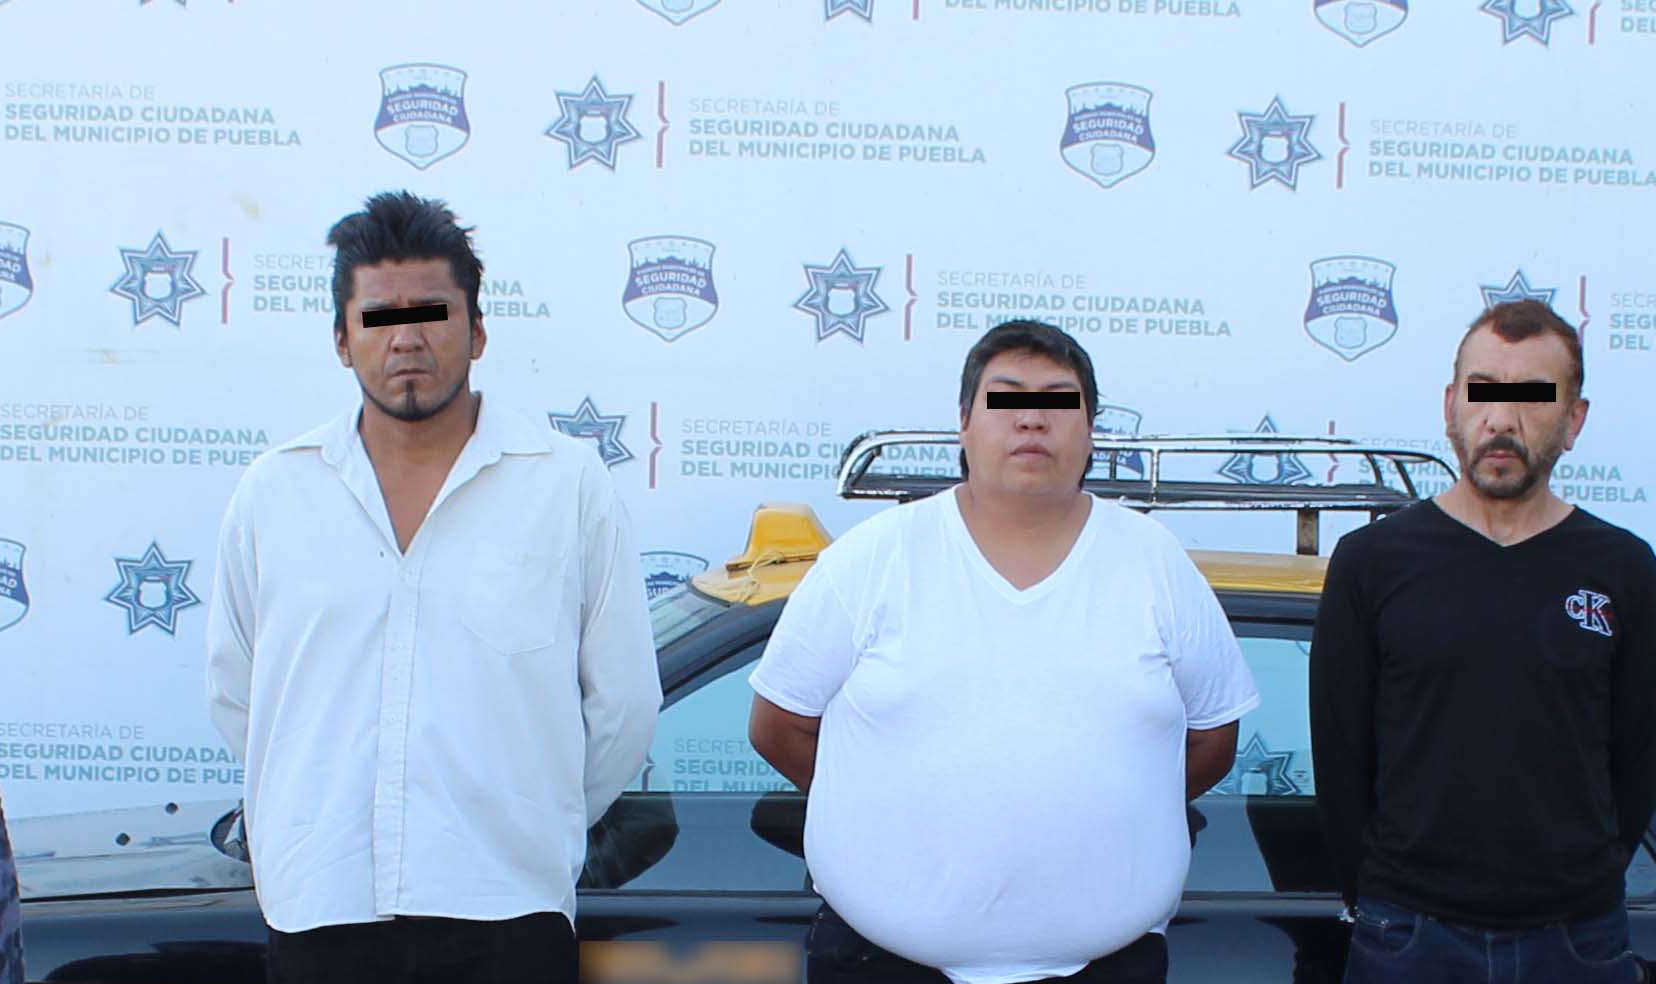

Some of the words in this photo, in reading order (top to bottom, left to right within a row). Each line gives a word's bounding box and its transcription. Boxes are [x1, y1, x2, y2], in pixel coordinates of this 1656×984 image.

[5, 103, 133, 121] SEGURIDAD
[141, 106, 274, 124] CIUDADANA
[5, 125, 46, 141] DEL
[53, 126, 170, 143] MUNICIPIO
[178, 127, 207, 144] DE
[214, 129, 301, 145] PUEBLA
[690, 118, 818, 137] SEGURIDAD
[826, 122, 959, 141] CIUDADANA
[690, 140, 731, 156] DEL
[738, 141, 855, 159] MUNICIPIO
[863, 143, 892, 161] DE
[899, 146, 986, 162] PUEBLA
[1370, 140, 1495, 159] SEGURIDAD
[1503, 145, 1633, 164] CIUDADANA
[1370, 161, 1410, 178] DEL
[1417, 163, 1531, 181] MUNICIPIO
[1539, 166, 1567, 183] DE
[936, 292, 1065, 310] SEGURIDAD
[1072, 296, 1205, 315] CIUDADANA
[936, 313, 978, 329] DEL
[1109, 317, 1139, 334] DE
[1145, 319, 1232, 336] PUEBLA
[1610, 334, 1650, 351] DEL
[0, 424, 128, 442] SEGURIDAD
[136, 427, 268, 445] CIUDADANA
[0, 446, 41, 462] DEL
[48, 447, 164, 464] MUNICIPIO
[172, 448, 201, 465] DE
[682, 440, 810, 458] SEGURIDAD
[44, 765, 160, 783] MUNICIPIO
[167, 767, 196, 784] DE
